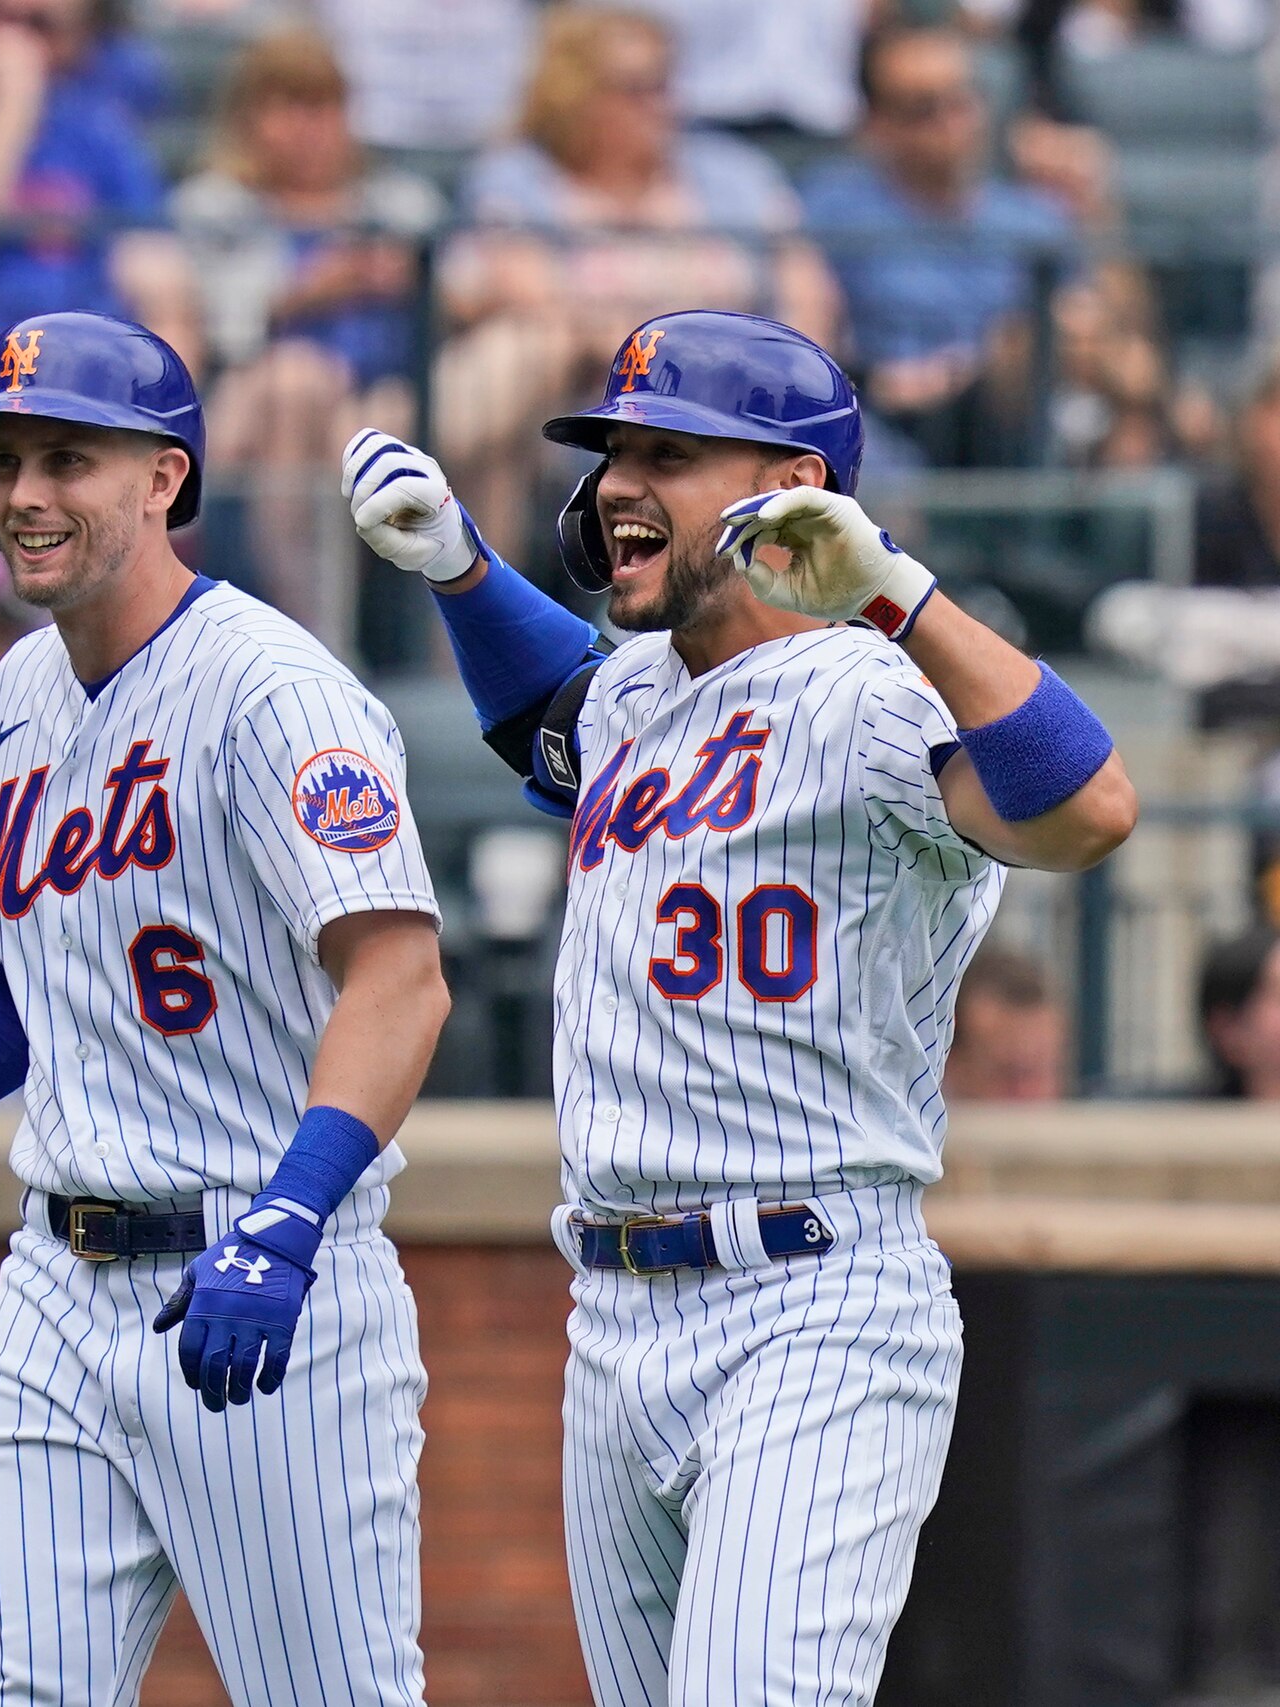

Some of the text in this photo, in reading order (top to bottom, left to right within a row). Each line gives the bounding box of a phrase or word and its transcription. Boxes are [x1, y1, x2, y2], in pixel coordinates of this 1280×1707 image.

[317, 785, 384, 830] Mets
[567, 709, 772, 884] Mets
[127, 924, 218, 1037] 6
[648, 882, 818, 1003] 30
